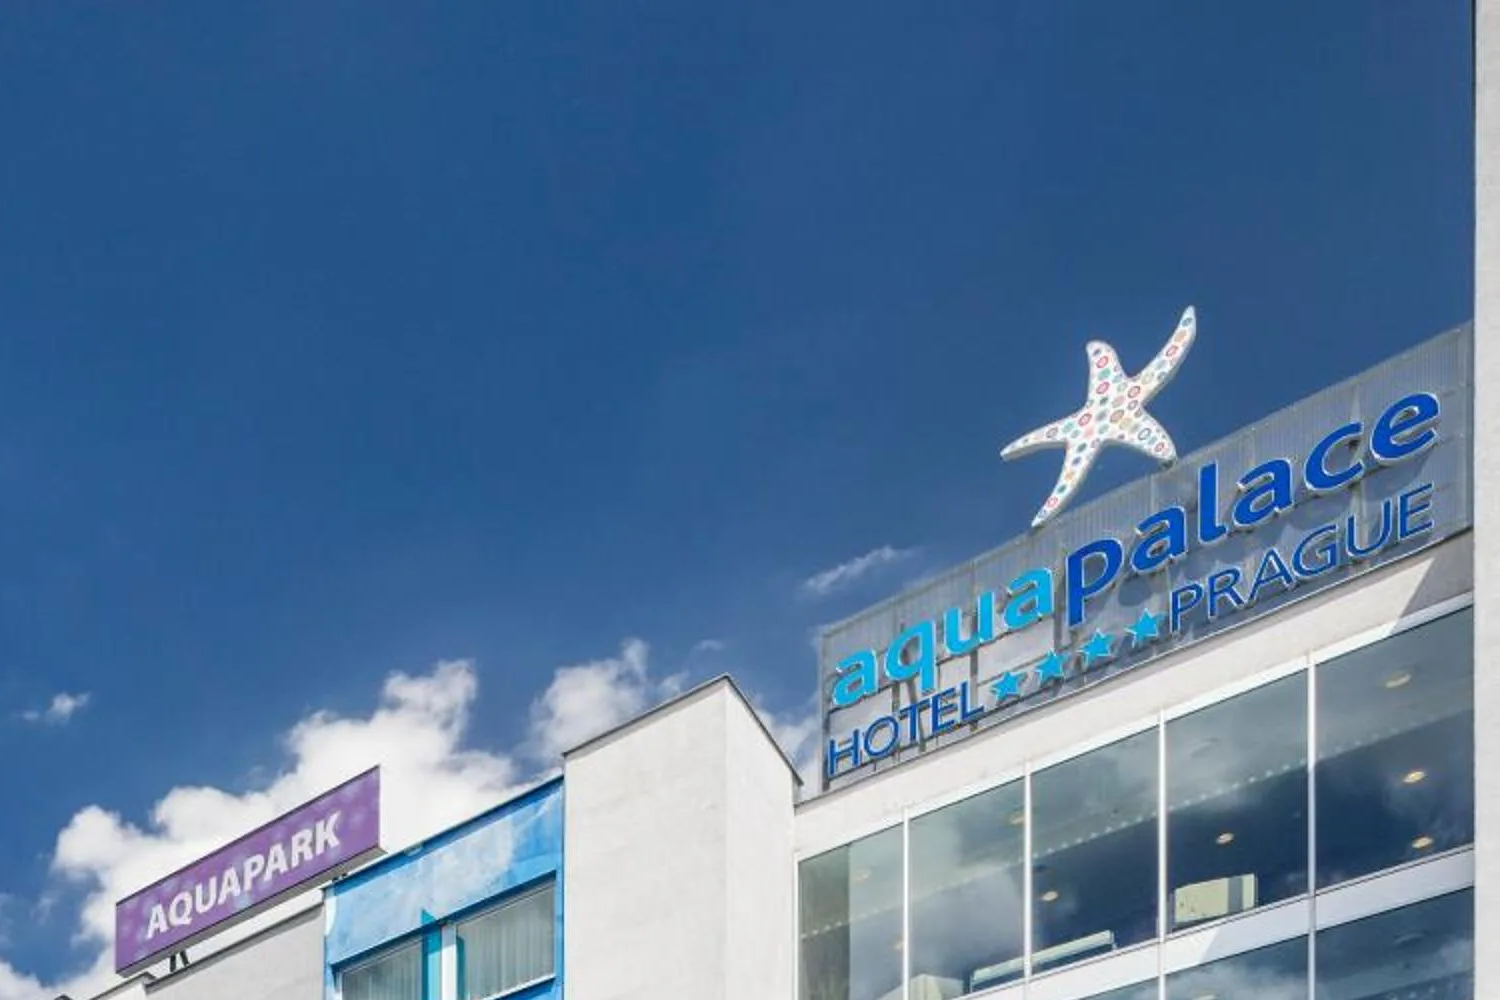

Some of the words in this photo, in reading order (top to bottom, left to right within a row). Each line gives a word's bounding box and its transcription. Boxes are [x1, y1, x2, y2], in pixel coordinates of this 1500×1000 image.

[827, 680, 985, 777] HOTEL
[1169, 483, 1435, 632] PRAGUE
[145, 810, 342, 940] AQUAPARK
